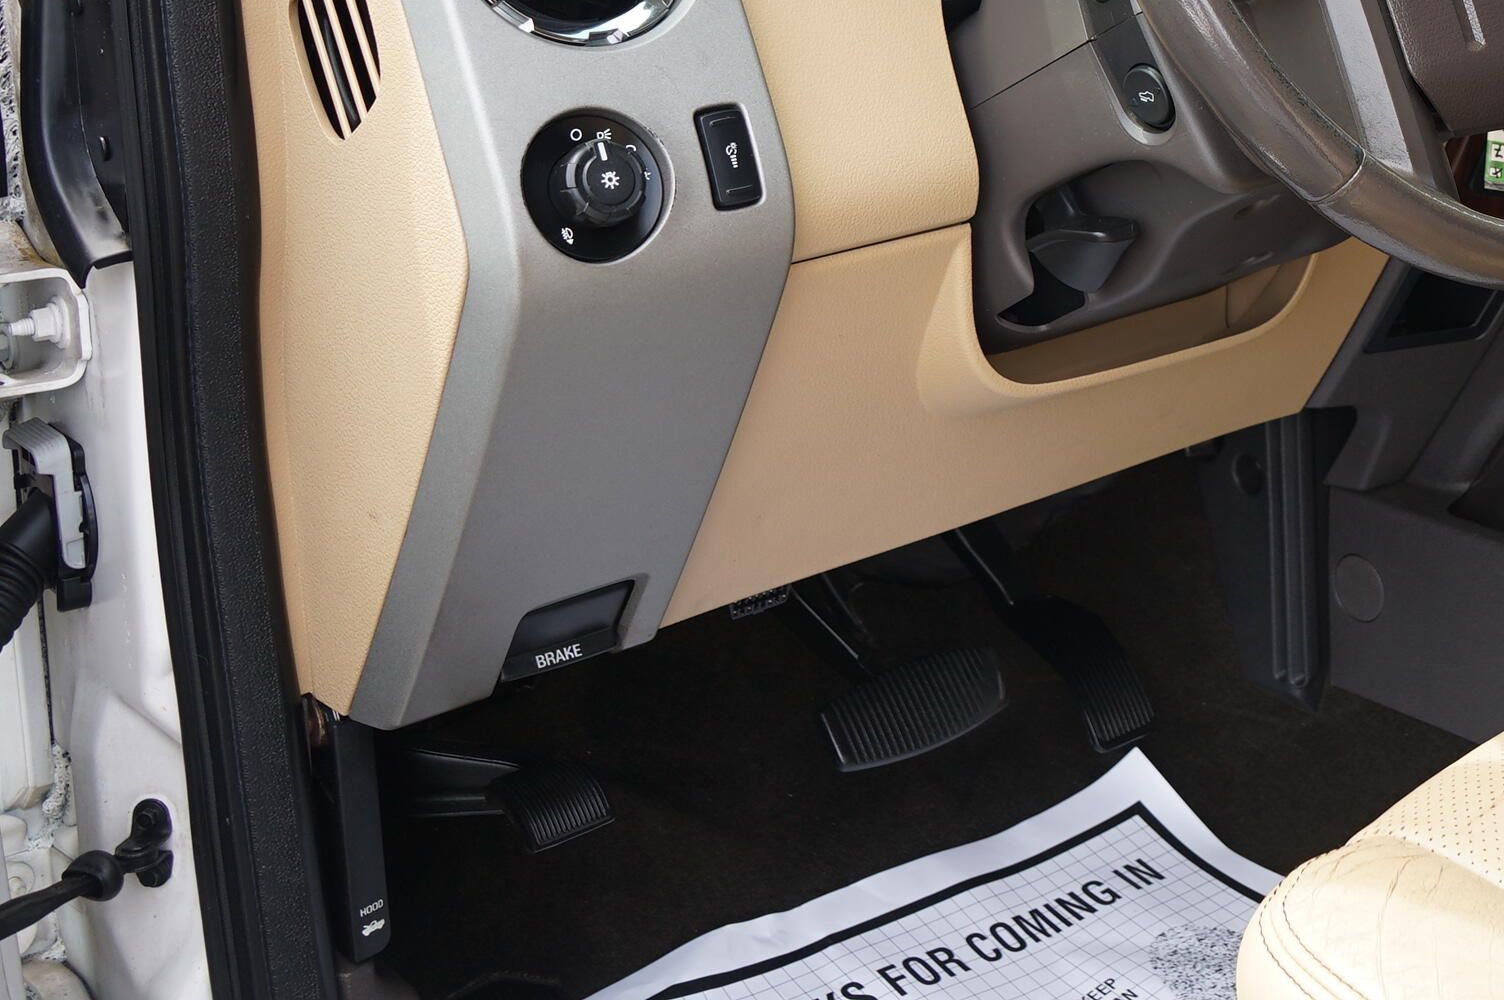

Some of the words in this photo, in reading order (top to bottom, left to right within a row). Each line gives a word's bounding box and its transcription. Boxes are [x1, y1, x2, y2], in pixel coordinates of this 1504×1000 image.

[535, 643, 583, 669] BRAKE
[360, 899, 384, 918] HOOD
[877, 946, 971, 996] FOR
[965, 879, 1122, 963] COMING
[1112, 858, 1167, 890] IN
